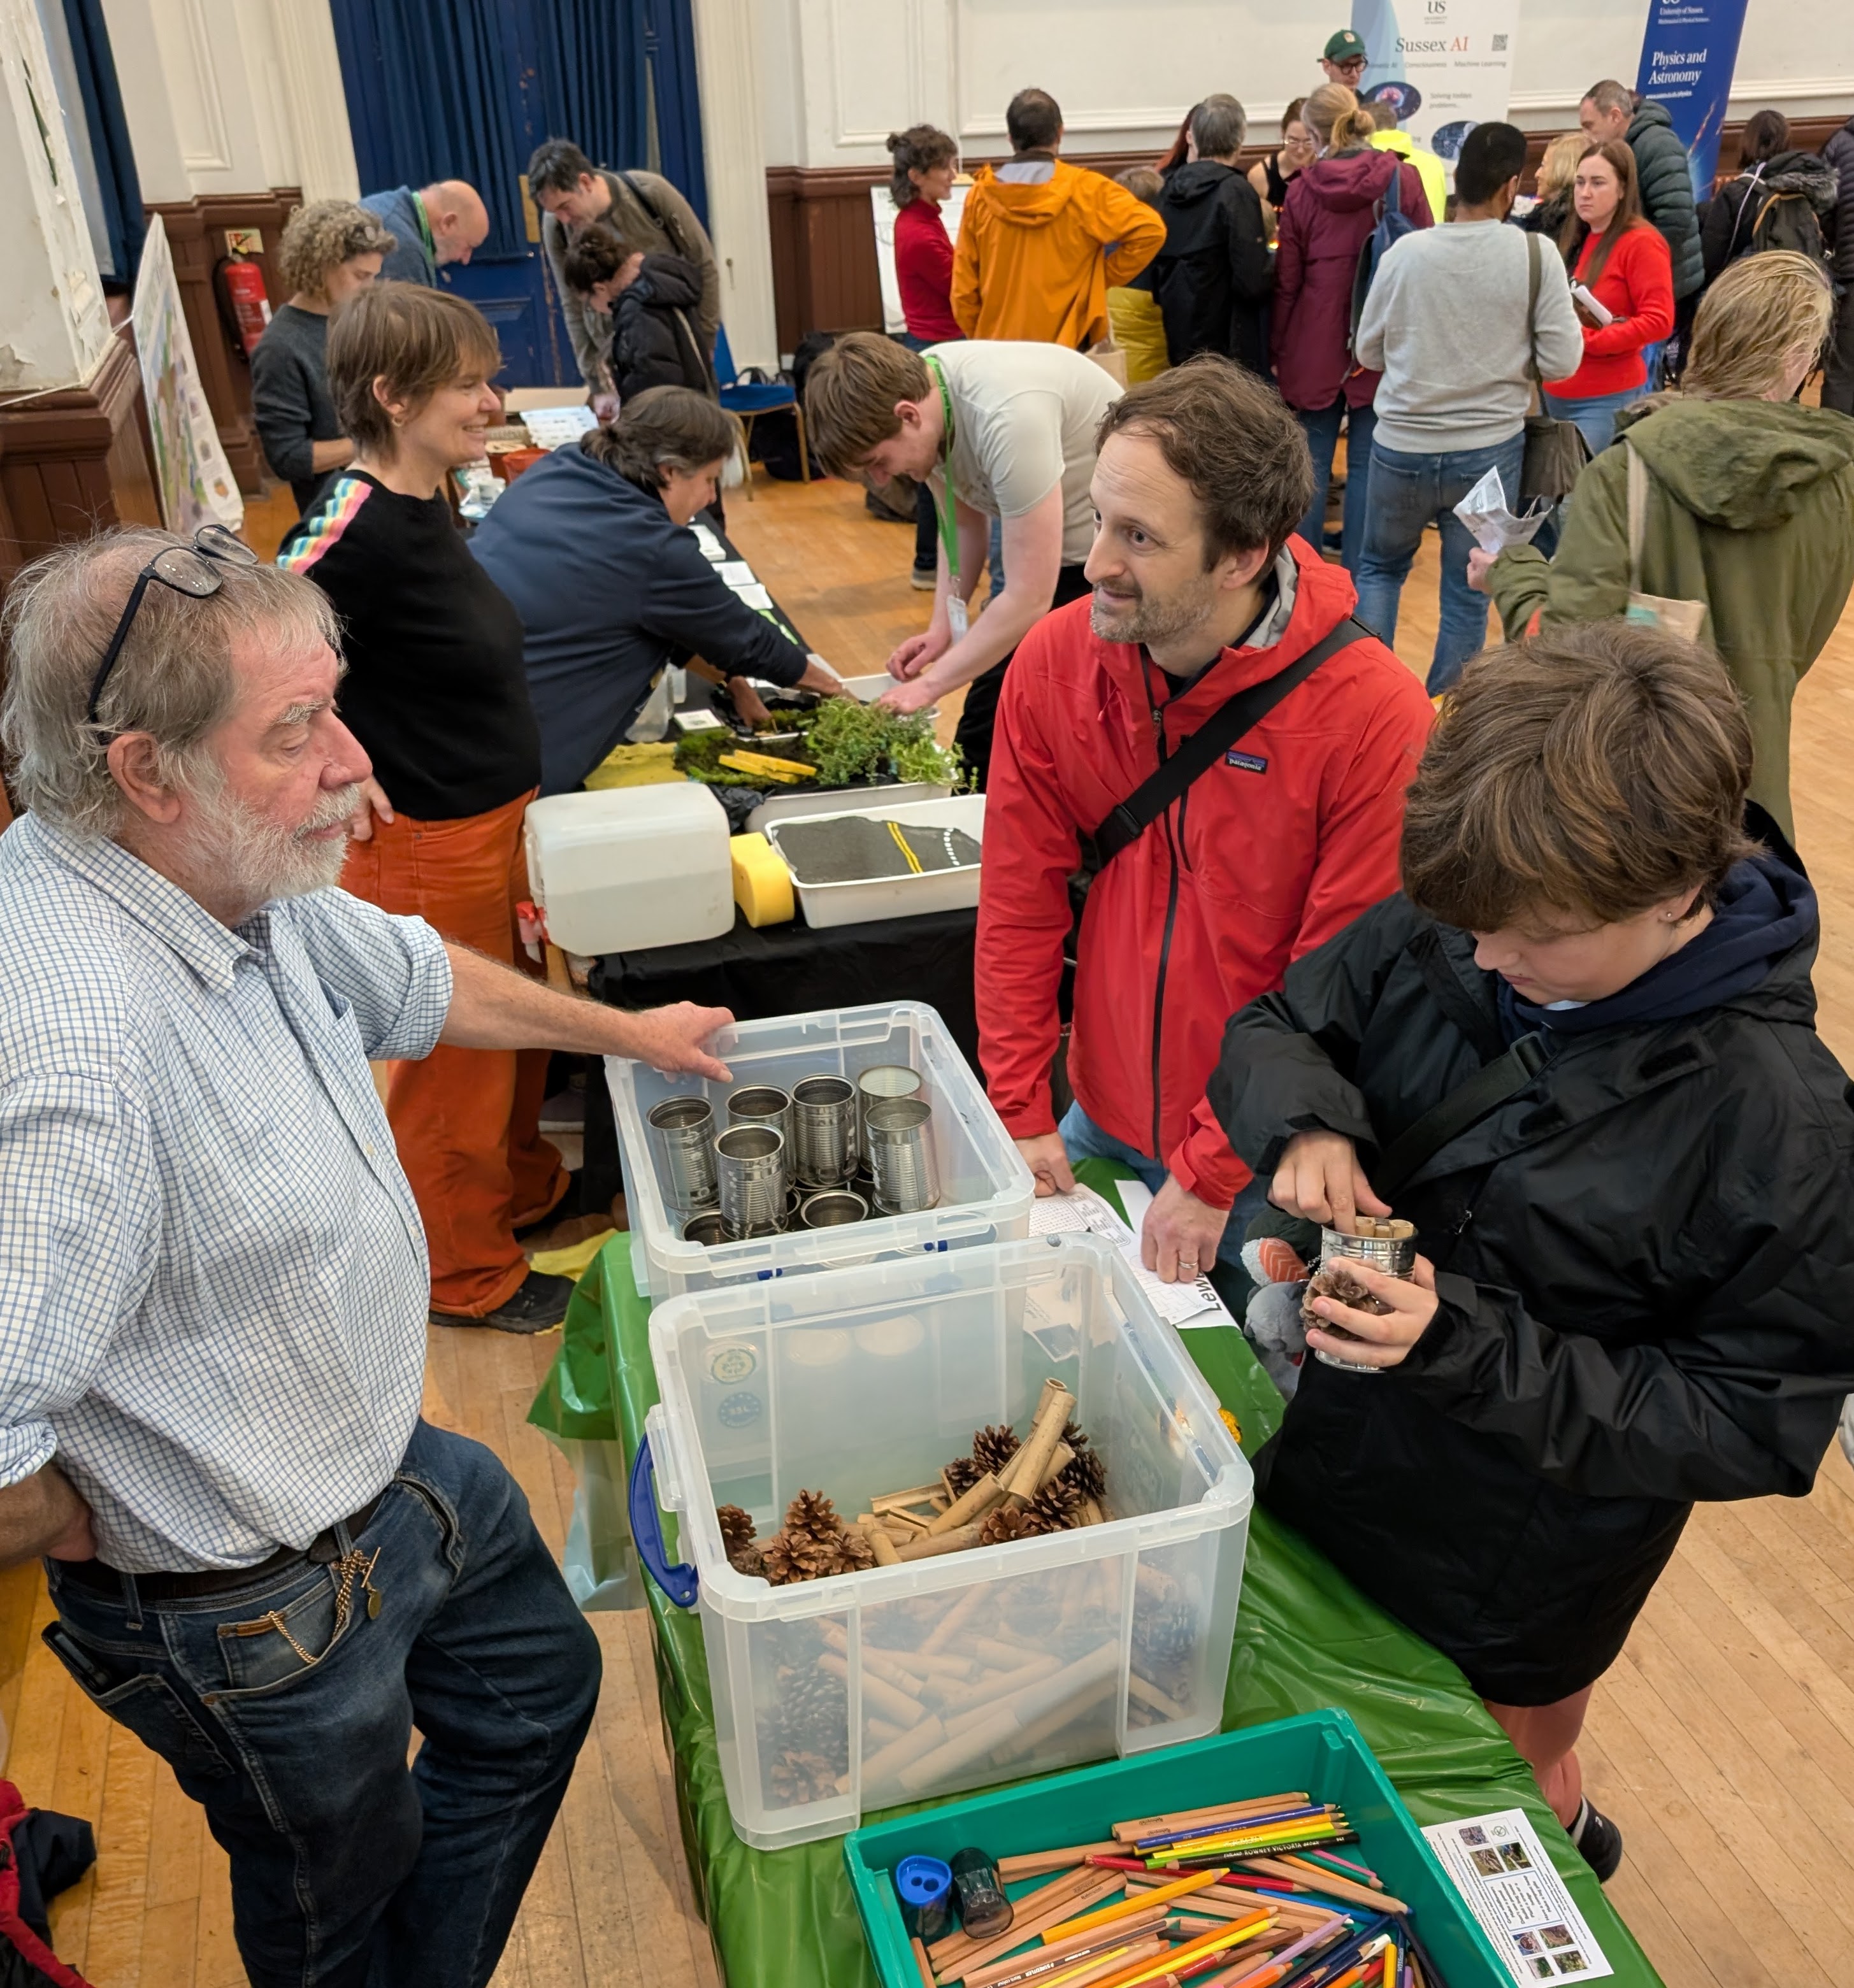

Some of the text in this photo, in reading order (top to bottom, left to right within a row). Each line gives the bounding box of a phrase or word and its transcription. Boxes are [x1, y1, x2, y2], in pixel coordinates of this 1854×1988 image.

[1395, 36, 1470, 53] Sussex AI
[1652, 48, 1708, 71] Physics and
[1648, 70, 1702, 86] Astronomy
[1228, 758, 1262, 771] patagonia
[1244, 1847, 1271, 1856] ROWNEY
[1271, 1842, 1302, 1852] VICTORIA
[1497, 1889, 1507, 1901] pond
[1500, 1881, 1514, 1903] pesticides
[1507, 1883, 1516, 1895] hotel
[1528, 1886, 1541, 1905] compost
[1490, 1886, 1512, 1924] Grow wildflowers
[1525, 1892, 1535, 1906] hedge
[1506, 1905, 1515, 1917] Make
[1526, 1905, 1535, 1917] Plant
[1543, 1900, 1551, 1912] Make
[1516, 1911, 1525, 1924] Don't
[1520, 1907, 1529, 1919] Build
[1541, 1908, 1549, 1920] Have
[1025, 1963, 1051, 1977] STAEDTLER
